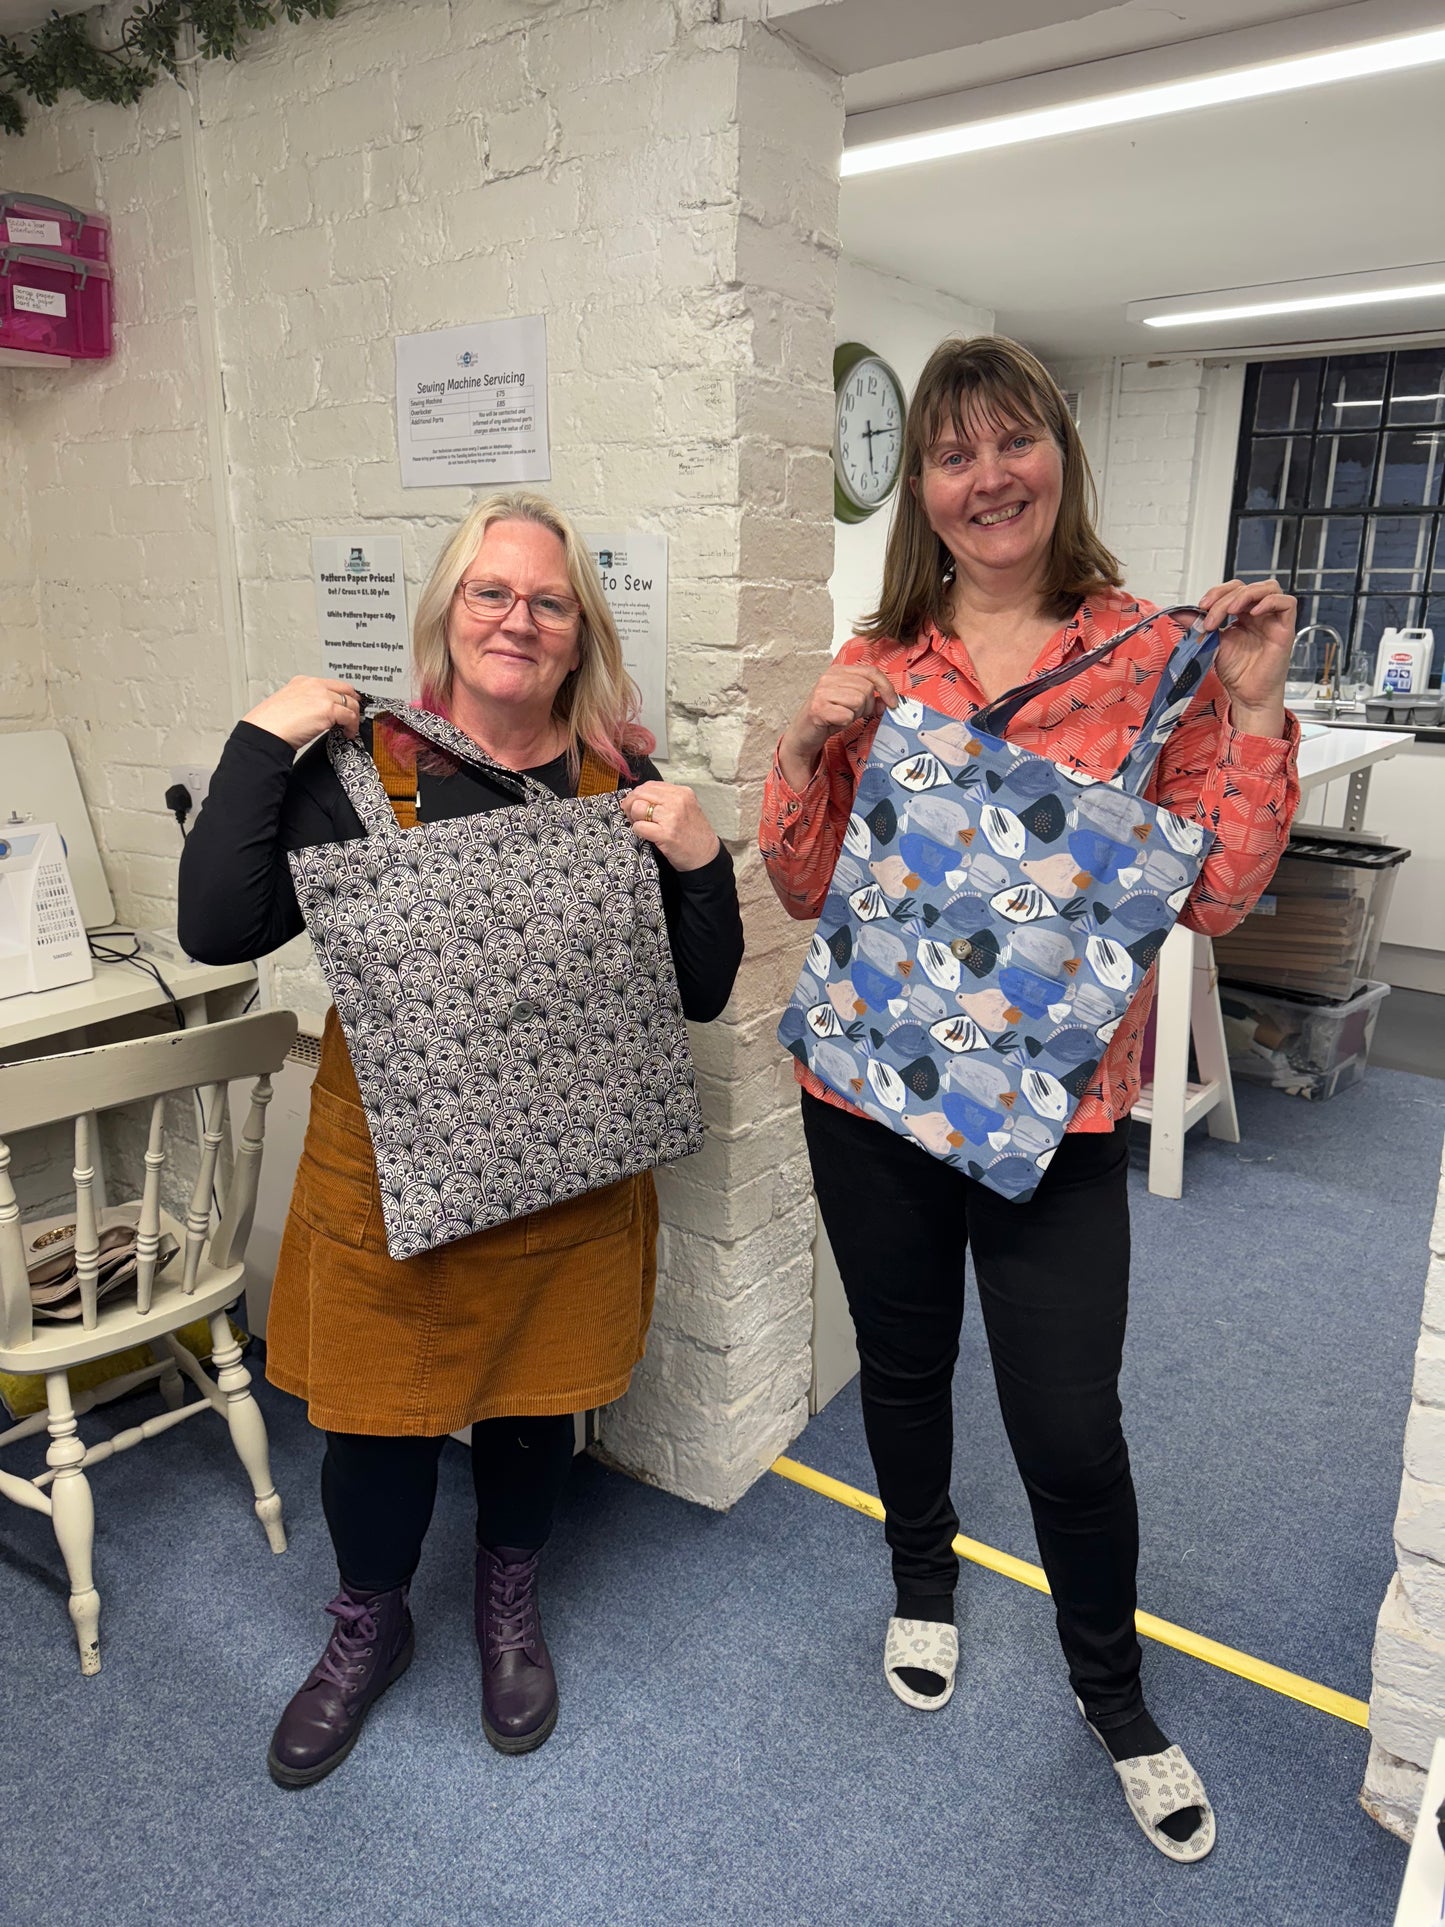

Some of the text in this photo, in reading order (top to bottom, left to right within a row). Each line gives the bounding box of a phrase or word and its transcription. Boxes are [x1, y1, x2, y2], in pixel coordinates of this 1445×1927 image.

[417, 371, 525, 394] Sewing Machine Servicing
[856, 378, 864, 398] 11
[867, 375, 878, 396] 12
[845, 392, 854, 412] 10
[881, 389, 886, 408] 1
[886, 408, 894, 426] 2
[840, 417, 848, 436] 9
[842, 442, 850, 460] 8
[888, 434, 895, 452] 3
[850, 464, 857, 482] 7
[883, 454, 890, 474] 4
[860, 472, 868, 490] 6
[872, 470, 879, 488] 5
[321, 573, 395, 585] Pattern Paper Prices!
[600, 571, 652, 591] to Sew
[378, 588, 390, 598] p/m
[356, 620, 367, 630] p/m
[363, 612, 379, 620] Paper
[385, 613, 395, 622] 40p
[381, 642, 391, 651] 60p
[392, 643, 404, 652] p/m
[363, 664, 378, 673] Paper
[391, 666, 402, 674] p/m
